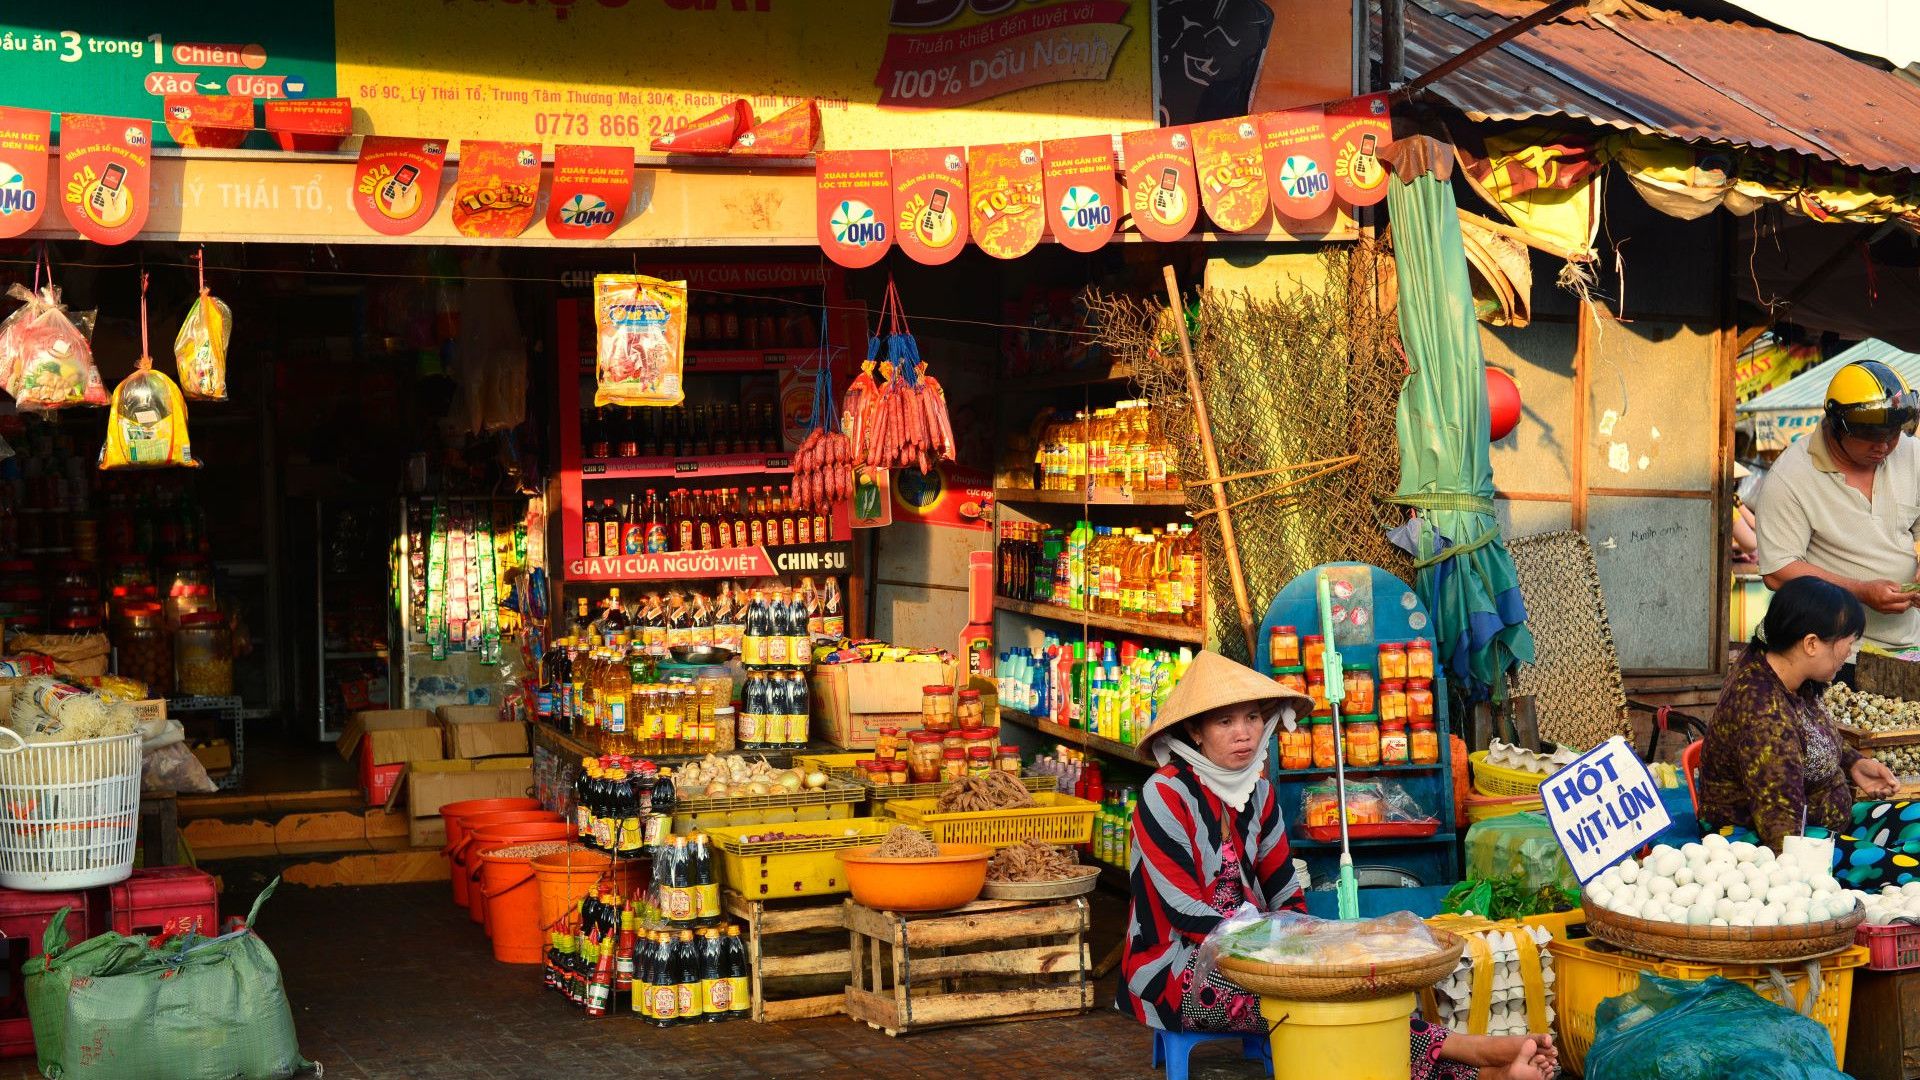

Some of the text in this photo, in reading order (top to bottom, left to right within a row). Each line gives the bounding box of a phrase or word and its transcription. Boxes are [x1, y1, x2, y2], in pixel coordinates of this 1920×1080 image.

[959, 24, 994, 49] khiết
[1000, 15, 1026, 38] đến
[1032, 10, 1067, 30] tuyệt
[0, 30, 163, 64] ầu ăn 3 trong 1
[175, 45, 238, 64] Chiên
[890, 66, 962, 99] 100%
[1033, 34, 1109, 69] Nành
[151, 75, 279, 99] Xào Ướp
[360, 83, 378, 98] Số
[492, 86, 528, 104] Trung
[534, 88, 561, 103] Tâm
[535, 113, 589, 136] 0773
[600, 114, 639, 136] 866
[1335, 141, 1357, 177] 8024
[66, 165, 97, 204] 8024
[358, 164, 391, 195] 8024
[1135, 174, 1157, 211] 8024
[1205, 166, 1232, 193] 10
[1296, 172, 1329, 195] OMO
[0, 188, 36, 211] MO
[217, 178, 280, 209] THÁI
[463, 189, 497, 211] 10
[977, 192, 1007, 220] 10
[574, 210, 615, 225] OMO
[899, 193, 925, 230] 8024
[1077, 205, 1111, 227] OMO
[847, 222, 886, 242] OMO
[570, 552, 845, 577] GIA VỊ CỦA NGƯỜI VIỆT CHIN-SU
[1552, 753, 1617, 812] HỘT
[1609, 783, 1656, 831] LỘN
